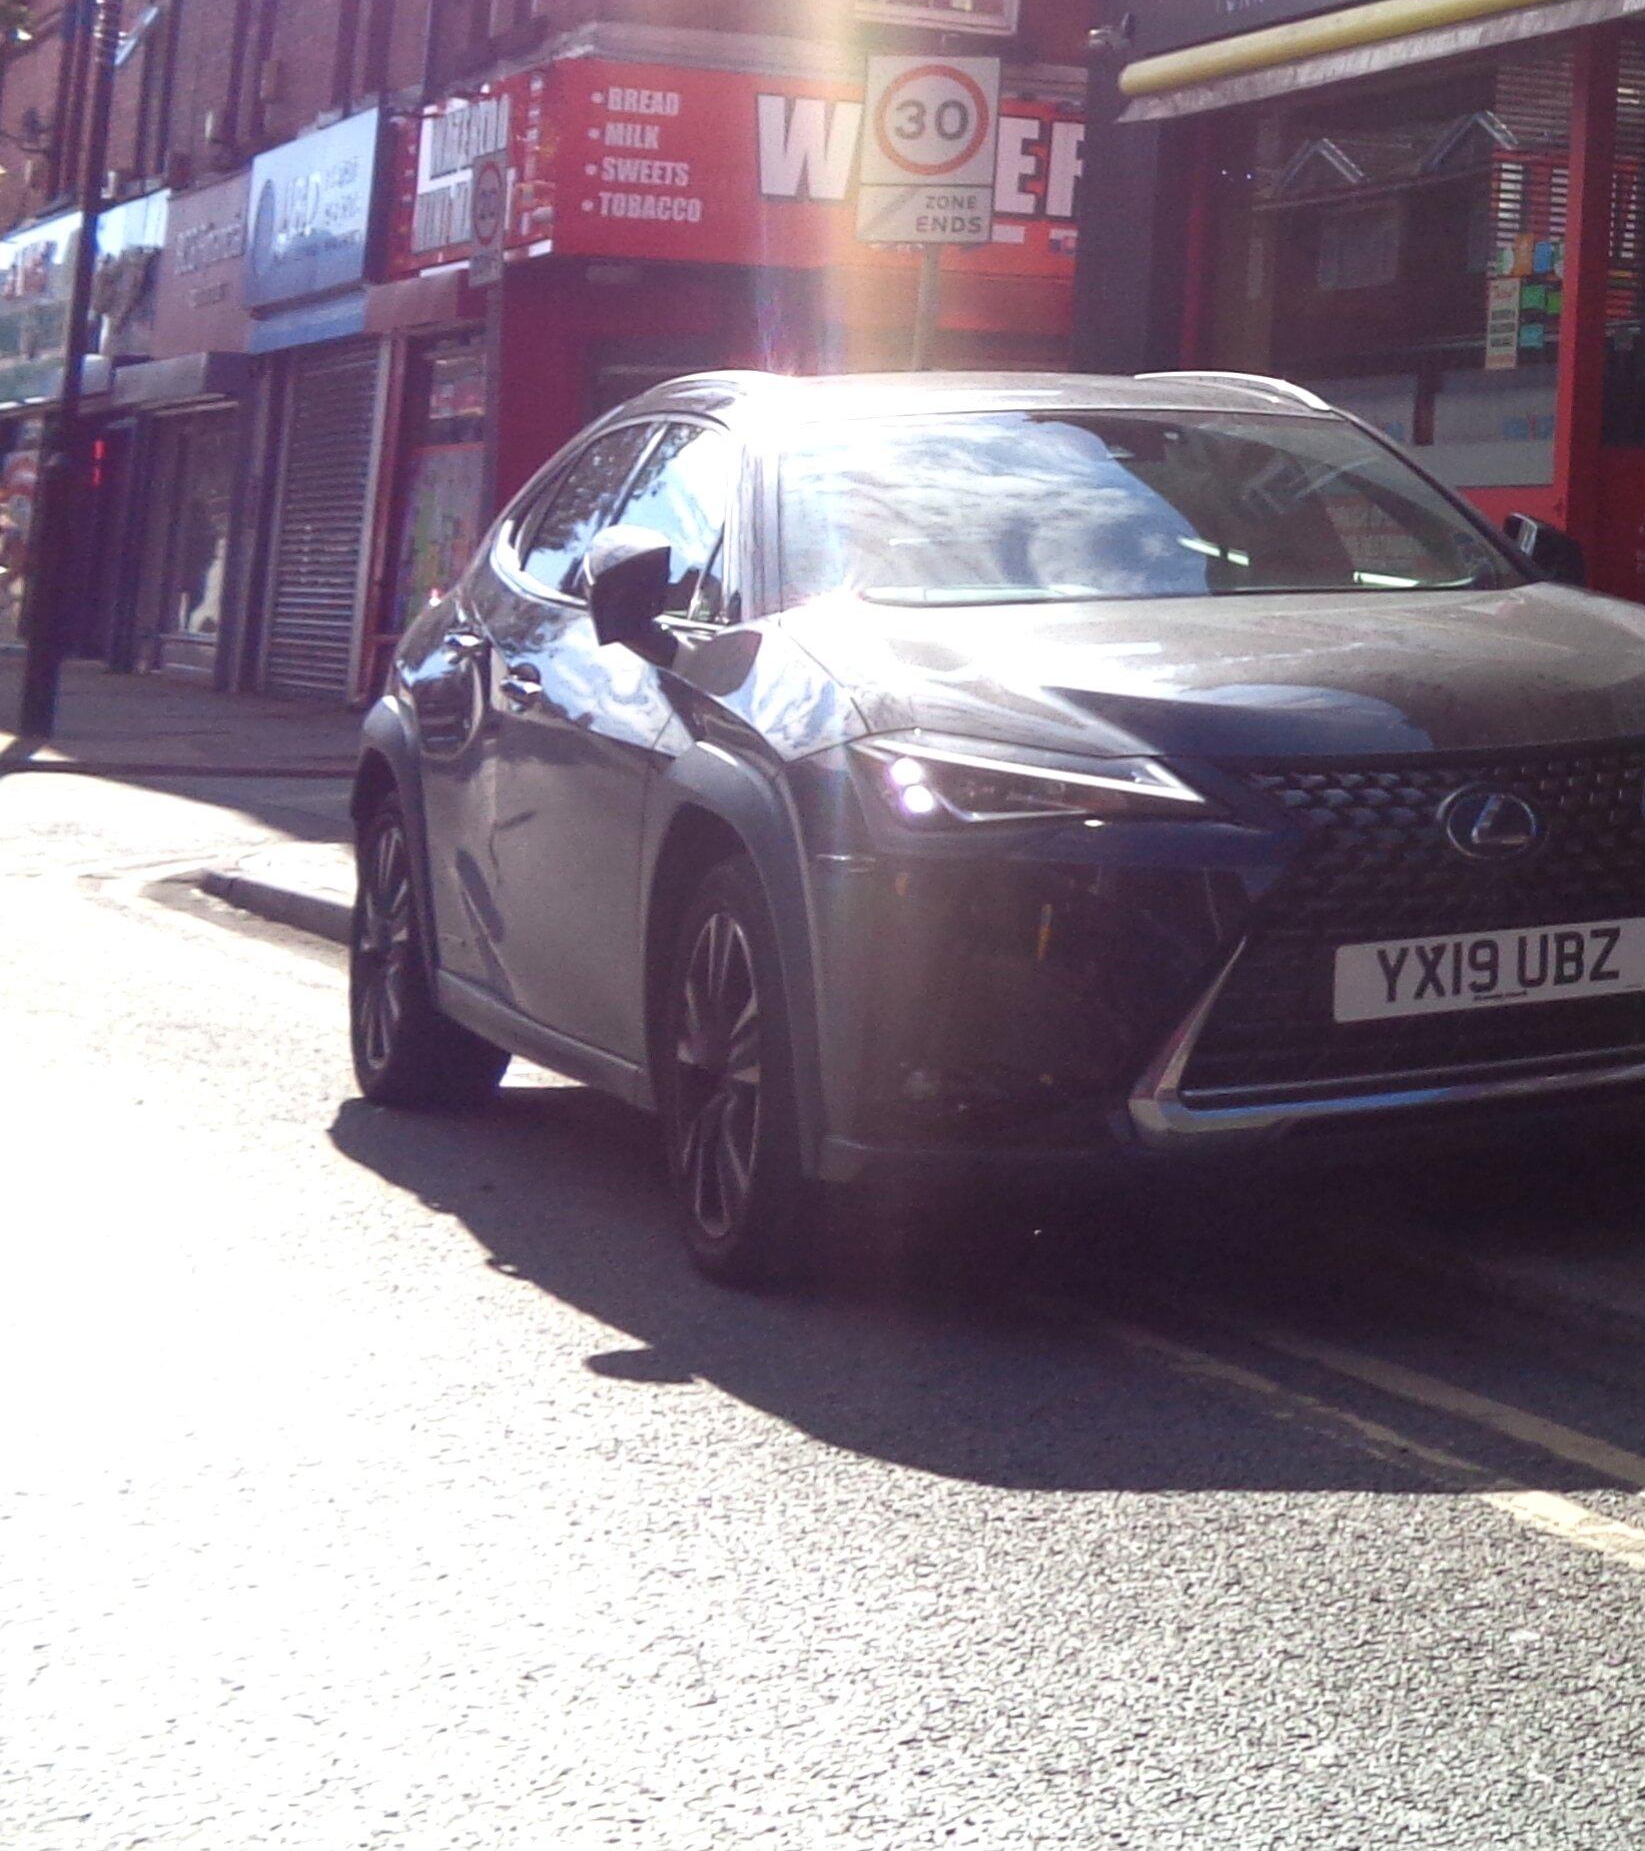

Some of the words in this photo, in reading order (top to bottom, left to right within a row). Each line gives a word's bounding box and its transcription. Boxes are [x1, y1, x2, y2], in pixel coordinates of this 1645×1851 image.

[606, 87, 680, 117] BREAD
[894, 98, 969, 142] 30
[603, 122, 659, 150] MILK
[600, 156, 690, 187] SWEETS
[597, 191, 703, 224] TOBACCO
[925, 194, 977, 212] ZONE
[915, 215, 982, 235] ENDS
[1377, 938, 1500, 1004] YX19
[1516, 926, 1622, 989] UBZ
